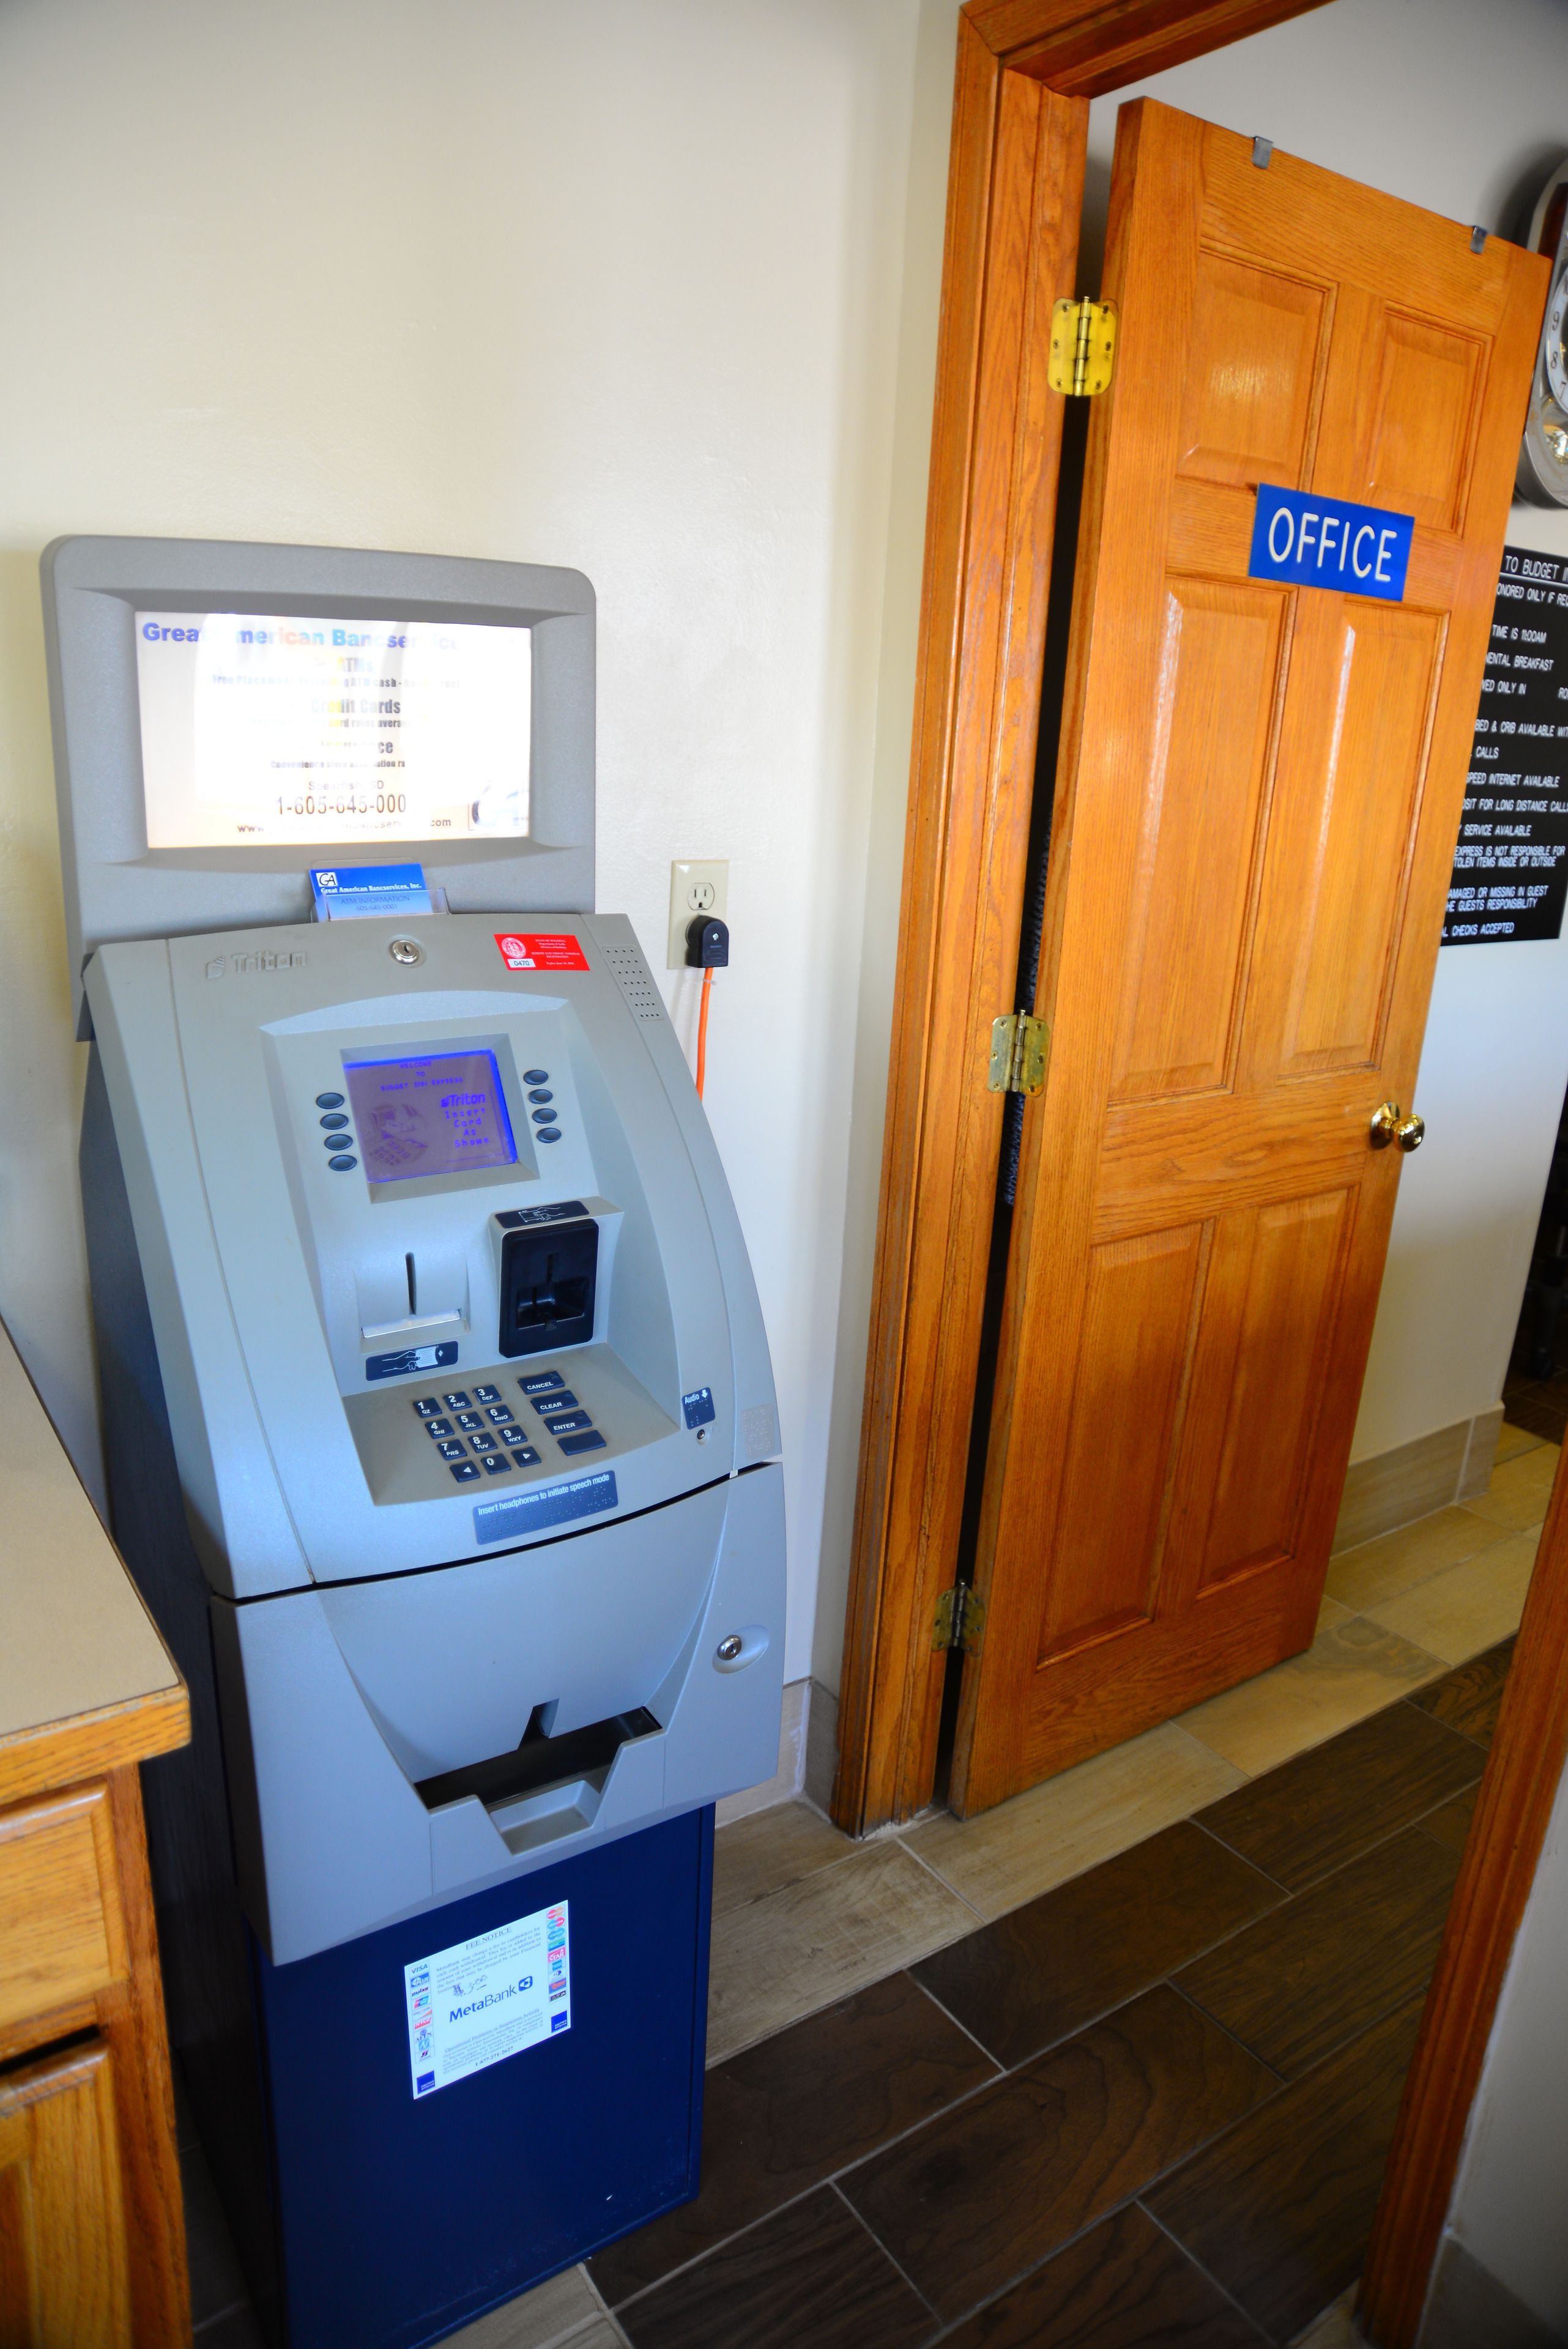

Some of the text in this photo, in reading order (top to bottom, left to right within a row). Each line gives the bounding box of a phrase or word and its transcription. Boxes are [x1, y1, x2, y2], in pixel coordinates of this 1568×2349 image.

[1269, 507, 1397, 581] OFFICE
[1506, 555, 1518, 573] TO
[1522, 558, 1559, 579] BUDGET
[1527, 588, 1546, 602] ONLY
[143, 622, 203, 642] Grea
[1493, 624, 1509, 639] TIME
[1510, 628, 1518, 640] IS
[1514, 655, 1554, 671] BREAKFAST
[1498, 680, 1517, 694] ONLY
[1518, 683, 1526, 695] IN
[1501, 721, 1516, 733] CRIB
[1518, 723, 1555, 737] AVAILABLE
[1476, 746, 1499, 759] CALLS
[1489, 773, 1522, 785] INTERNET
[1523, 775, 1560, 788] AVAILABLE
[1479, 798, 1493, 811] FOR
[1495, 799, 1514, 811] LONG
[1515, 800, 1548, 812] DISTANCE
[1464, 824, 1532, 837] SERVICE AVAILABLE
[1485, 845, 1493, 856] IS
[1495, 845, 1508, 856] NOT
[1510, 845, 1551, 856] RESPONSIBLE
[1553, 845, 1566, 856] FOR
[1476, 856, 1496, 867] ITEMS
[1498, 856, 1518, 867] INSIDE
[1520, 856, 1529, 867] OR
[1531, 856, 1556, 867] OUTSIDE
[1478, 887, 1488, 897] OR
[1490, 886, 1515, 898] MISSING
[1518, 886, 1525, 897] IN
[1527, 885, 1548, 897] GUEST
[359, 895, 411, 904] INFORMATION
[1458, 899, 1485, 911] GUESTS
[1487, 898, 1537, 910] RESPONSIBILITY
[1452, 924, 1478, 937] CHECKS
[1481, 922, 1514, 935] ACCEPTED
[231, 950, 307, 975] Triton
[448, 1093, 486, 1107] Triton
[445, 1108, 485, 1119] Insert
[454, 1117, 481, 1127] Card
[455, 1137, 488, 1148] Shown
[527, 1381, 554, 1390] CANCEL
[685, 1393, 699, 1404] Audio
[553, 1422, 576, 1431] ENTER
[478, 1505, 499, 1516] Insert
[499, 1494, 539, 1510] headphones
[548, 1486, 569, 1498] initiate
[570, 1479, 592, 1492] speech
[593, 1474, 609, 1485] mode
[482, 1926, 511, 1943] NOTICE
[411, 1964, 428, 1974] VISA
[450, 1983, 517, 2022] MetaBank
